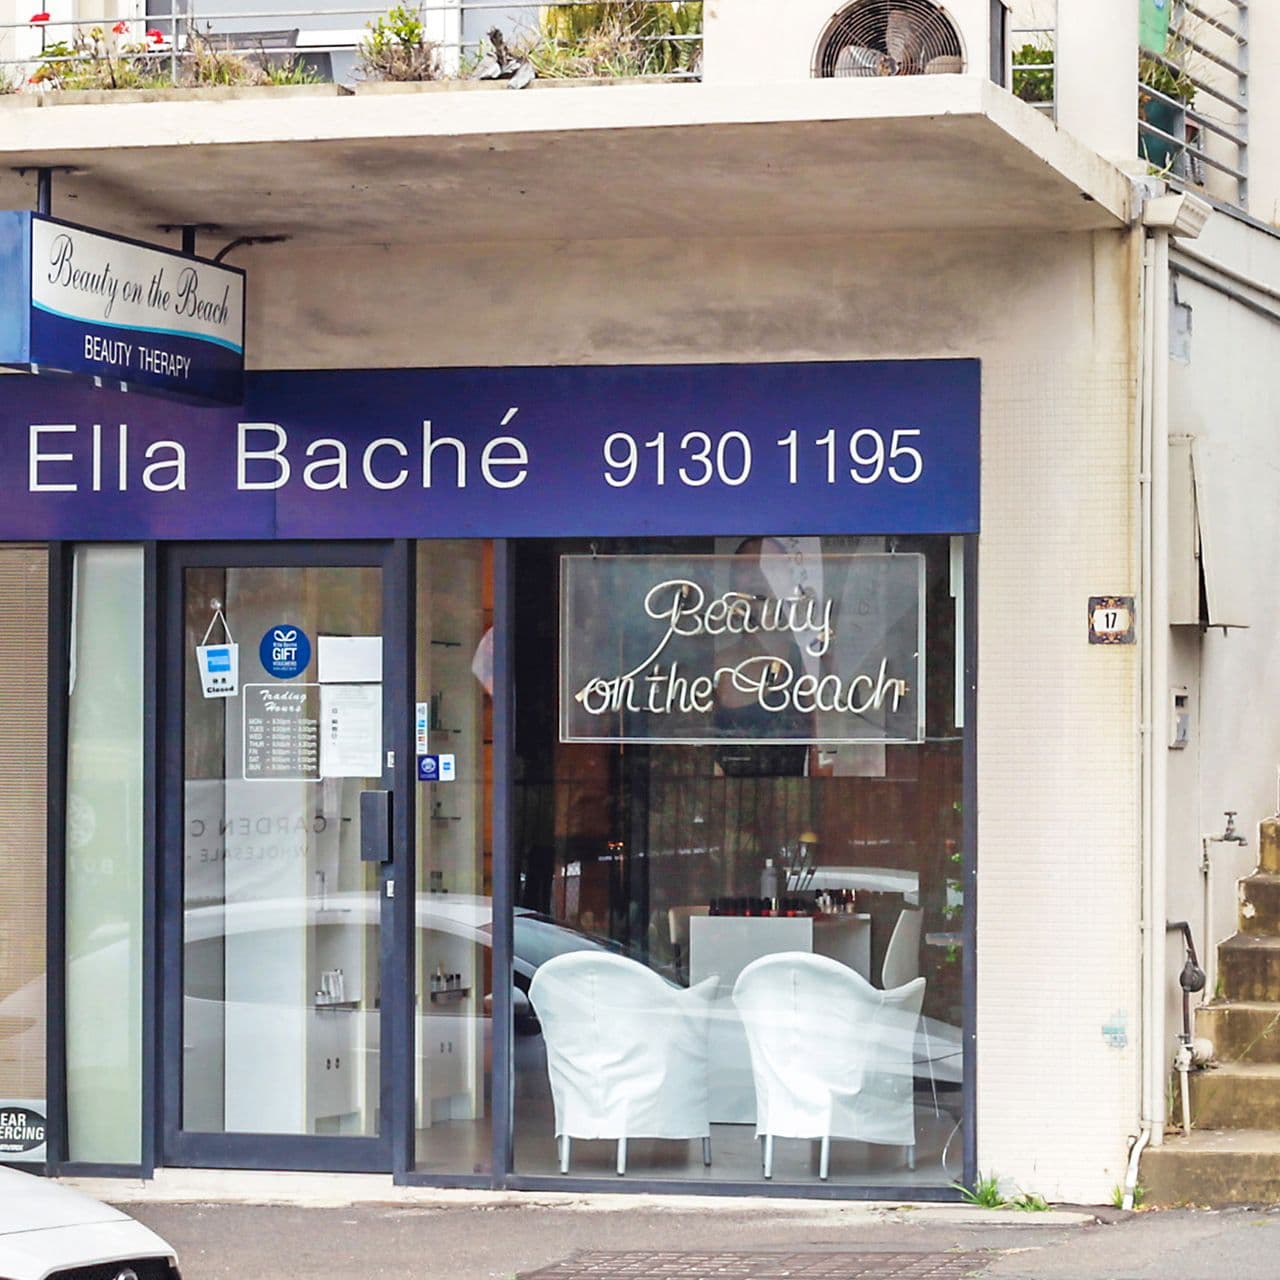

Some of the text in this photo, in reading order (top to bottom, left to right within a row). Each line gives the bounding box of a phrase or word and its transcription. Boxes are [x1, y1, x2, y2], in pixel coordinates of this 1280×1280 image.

[48, 233, 230, 325] Beauty on the Beach
[84, 334, 191, 380] BEAUTY THERAPY
[28, 407, 529, 492] Ella Baché
[603, 428, 924, 488] 9130 1195
[642, 579, 834, 658] Beauty
[1104, 612, 1117, 629] 17
[272, 647, 298, 661] GIFT
[206, 686, 234, 694] Closed
[260, 689, 308, 703] Trading
[582, 655, 901, 715] on the Beach
[264, 701, 303, 712] Hours
[0, 1112, 27, 1127] EAR
